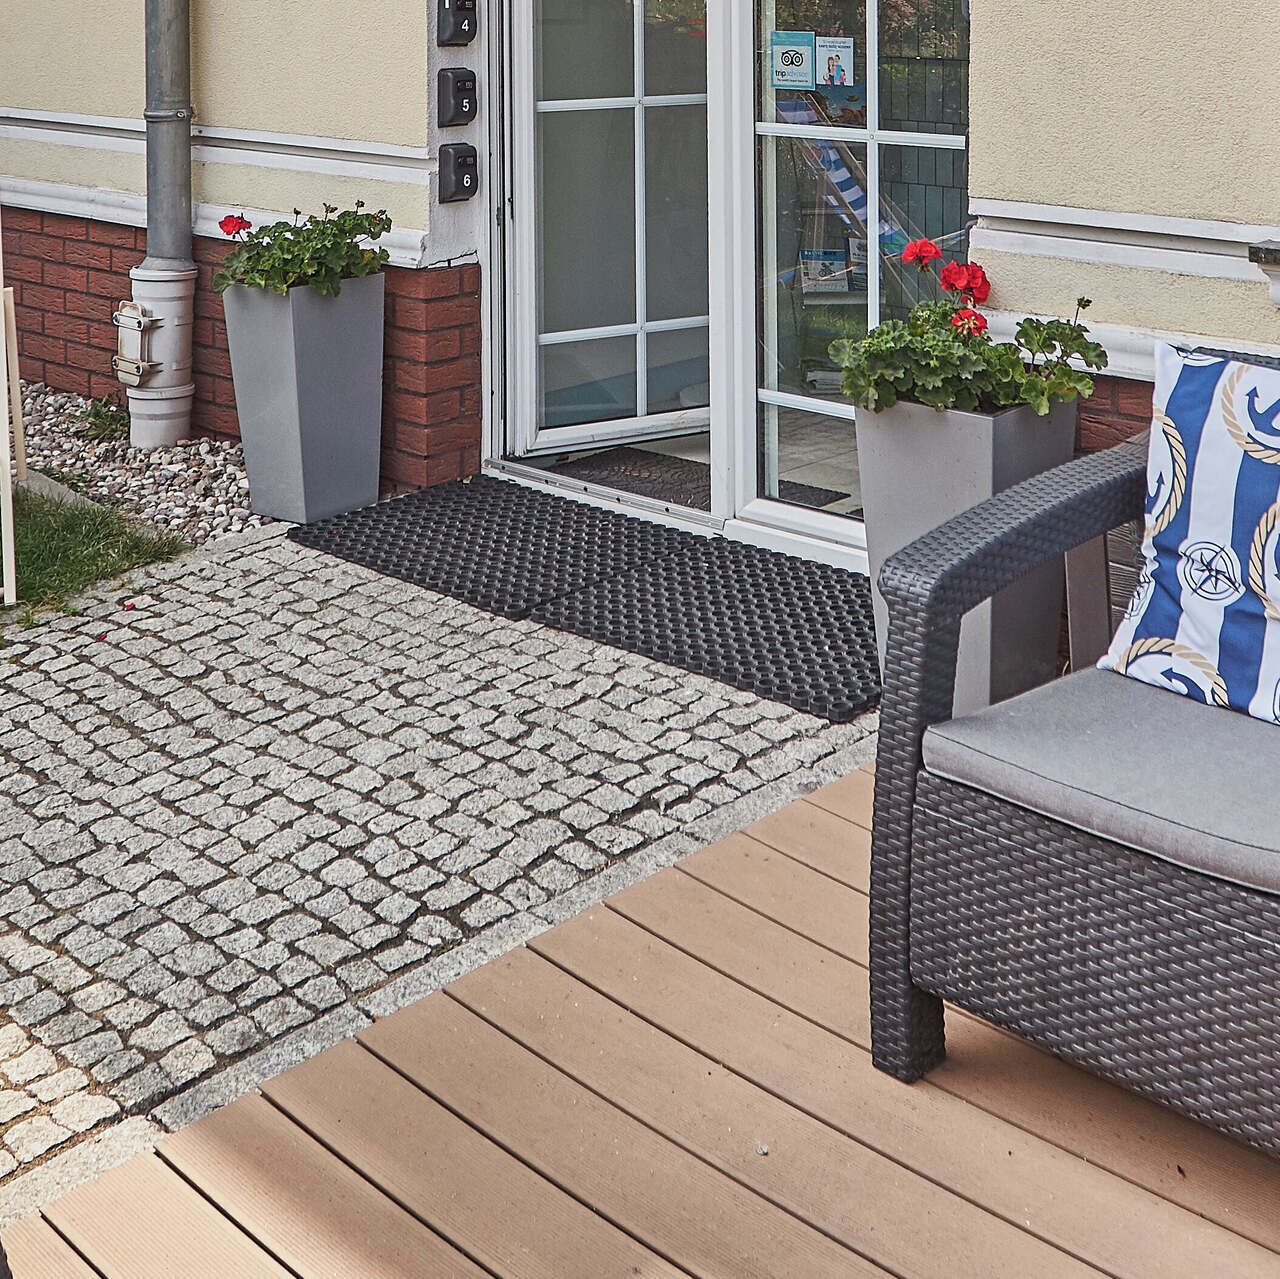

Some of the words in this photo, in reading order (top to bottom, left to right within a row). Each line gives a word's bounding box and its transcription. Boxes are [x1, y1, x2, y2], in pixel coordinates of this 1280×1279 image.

[461, 19, 470, 32] 4
[462, 99, 470, 112] 5
[463, 174, 471, 187] 6
